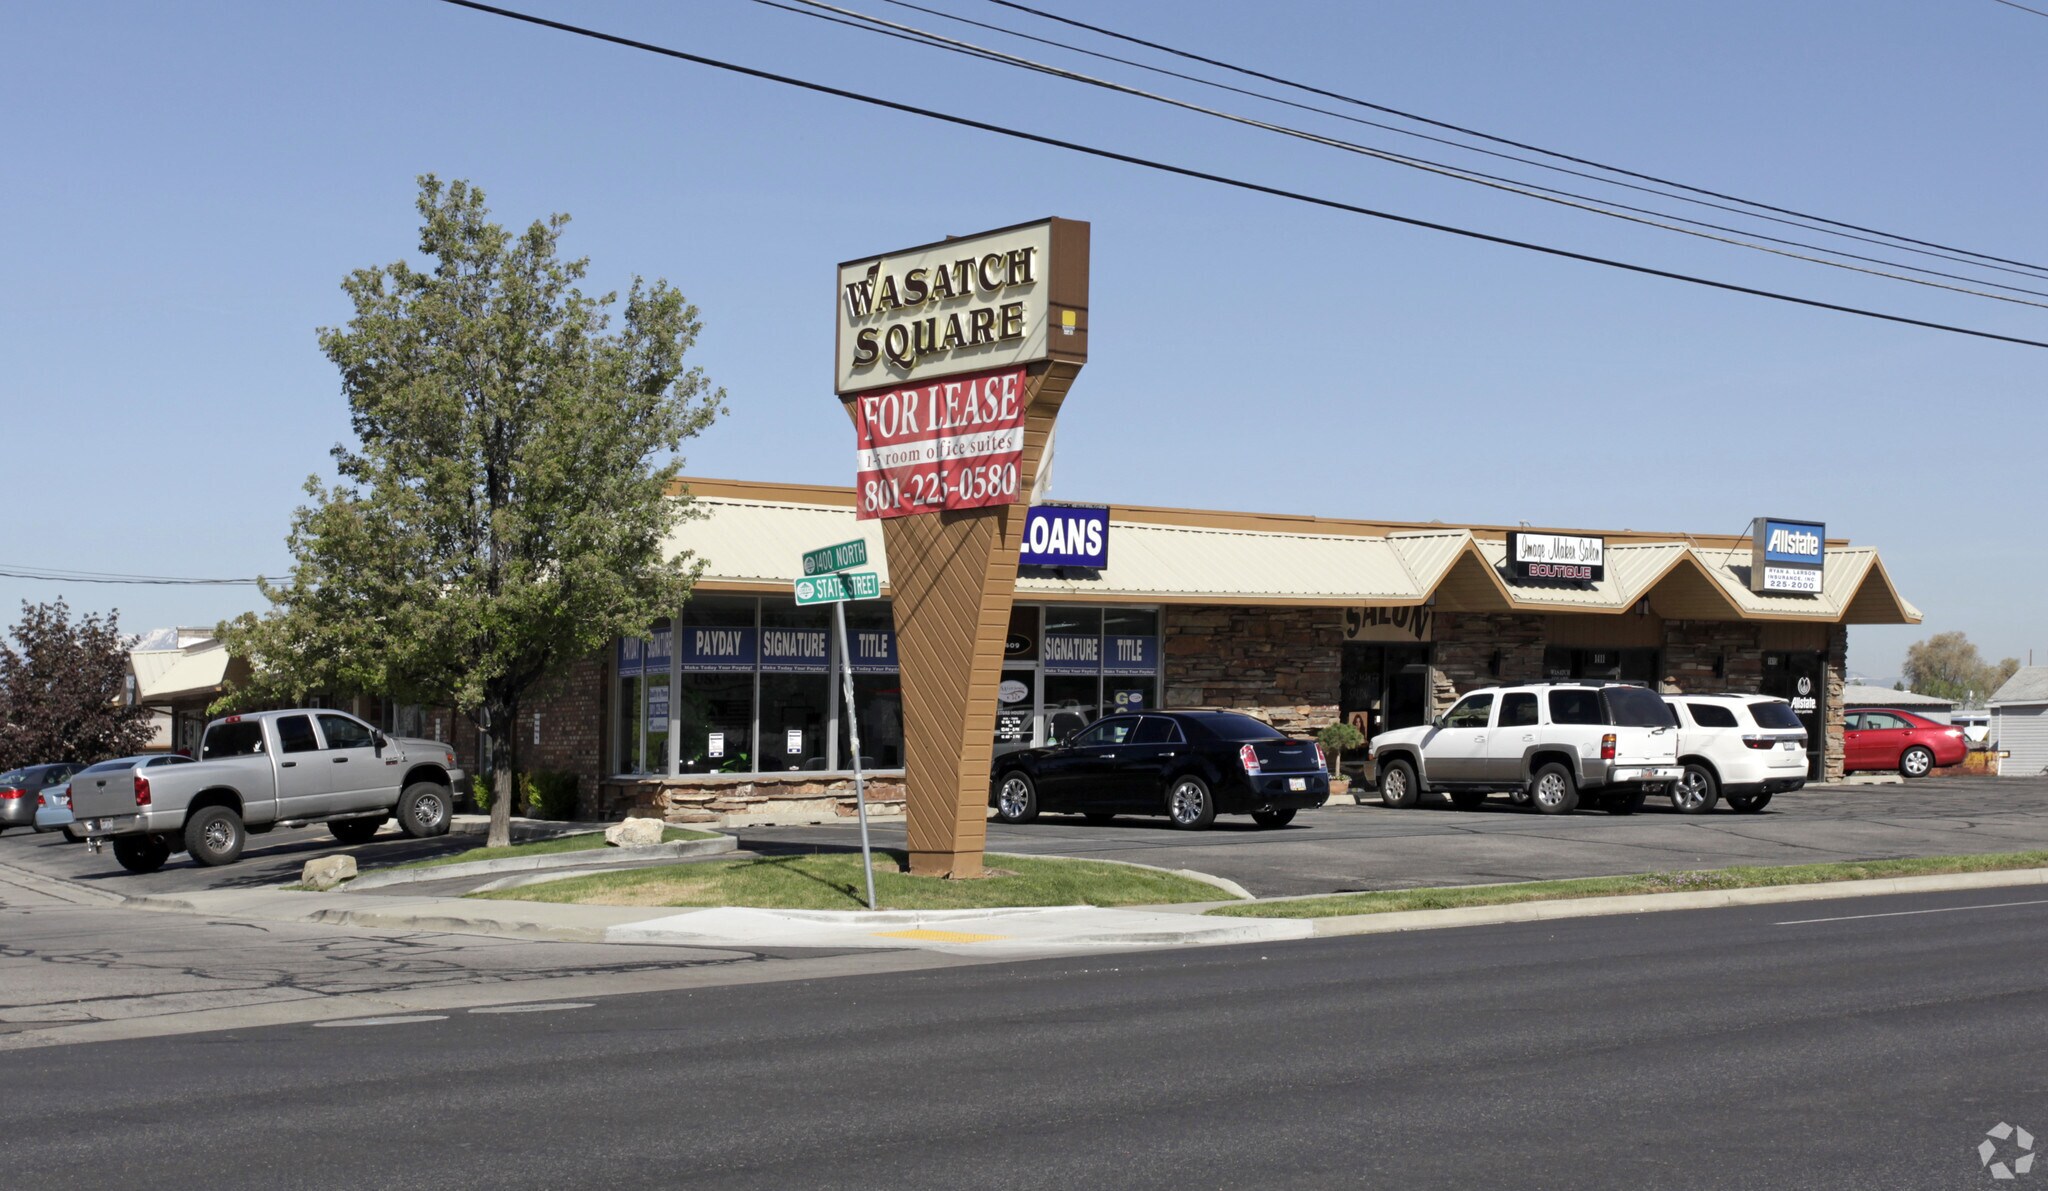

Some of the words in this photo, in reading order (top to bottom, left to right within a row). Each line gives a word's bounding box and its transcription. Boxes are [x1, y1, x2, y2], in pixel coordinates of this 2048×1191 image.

[845, 246, 1038, 318] WASATCH
[852, 301, 1026, 371] SQUARE
[864, 390, 919, 441] FOR
[926, 373, 1019, 432] LEASE
[886, 448, 920, 465] room
[926, 438, 965, 460] office
[969, 433, 1012, 454] suites
[864, 462, 1016, 512] 801-225-0580
[1020, 516, 1102, 557] OANS
[1520, 535, 1545, 563] Image
[1548, 537, 1576, 561] Maker
[1578, 539, 1600, 562] Salon
[1767, 529, 1819, 556] Allstate
[815, 550, 833, 572] 1400
[836, 542, 866, 567] NORTH
[1528, 563, 1592, 580] BOUTIQUE
[1770, 580, 1814, 589] 225-2000
[816, 577, 845, 599] STATE
[848, 575, 876, 596] STREET
[696, 630, 742, 656] PAYDAY
[763, 630, 825, 657] SIGNATURE
[859, 633, 888, 658] TITLE
[1045, 637, 1098, 661] SIGNATURE
[1117, 639, 1142, 662] TITLE
